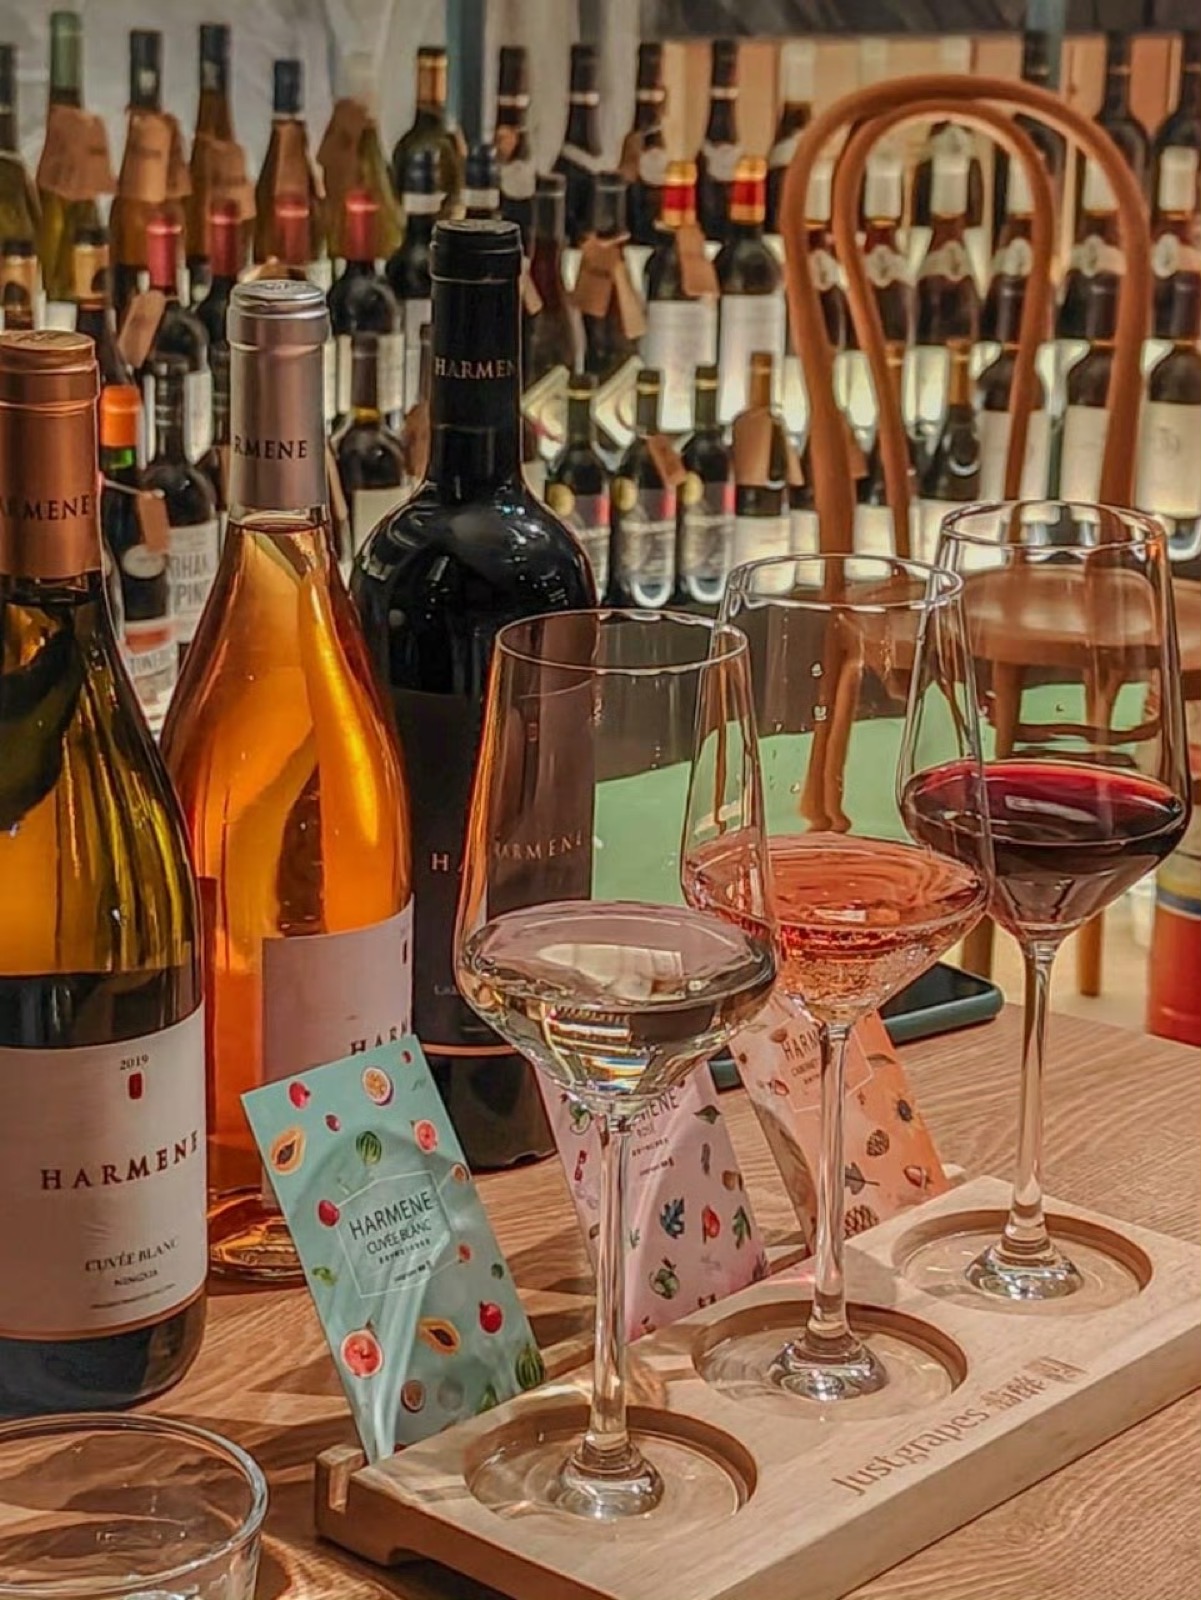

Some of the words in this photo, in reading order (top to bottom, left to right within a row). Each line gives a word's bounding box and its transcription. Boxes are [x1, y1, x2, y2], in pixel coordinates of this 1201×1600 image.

[119, 1054, 150, 1071] 2019
[41, 1130, 199, 1190] HARMENE
[349, 1191, 433, 1240] HARMENE
[400, 1219, 433, 1241] BLANC
